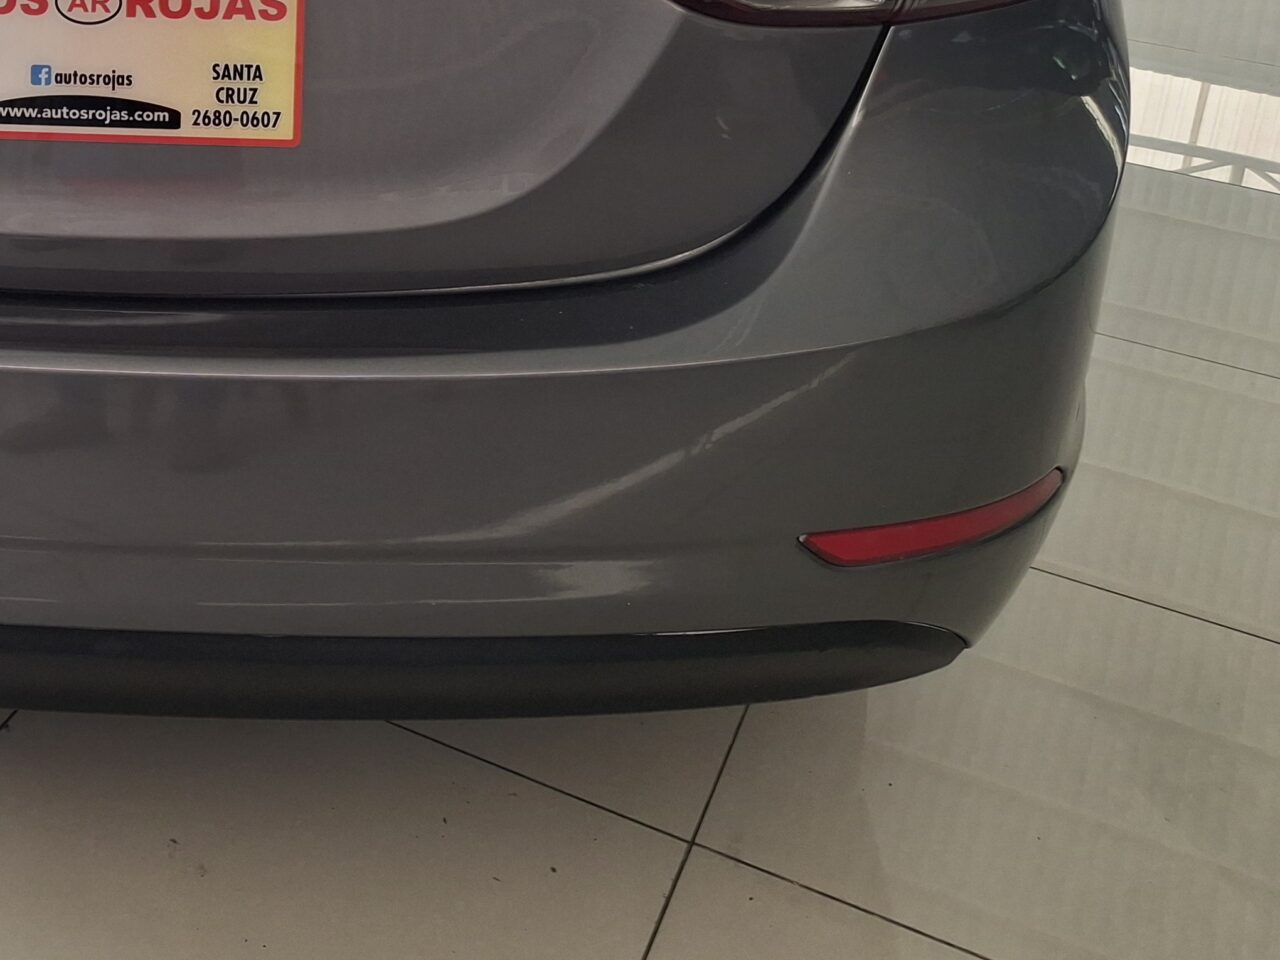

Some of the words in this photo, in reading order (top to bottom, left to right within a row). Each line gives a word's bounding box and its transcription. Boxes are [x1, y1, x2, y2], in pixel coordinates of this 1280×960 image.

[54, 70, 133, 91] autosrojas
[211, 64, 264, 82] SANTA
[215, 88, 259, 105] CRUZ
[191, 109, 282, 129] 2680-0607
